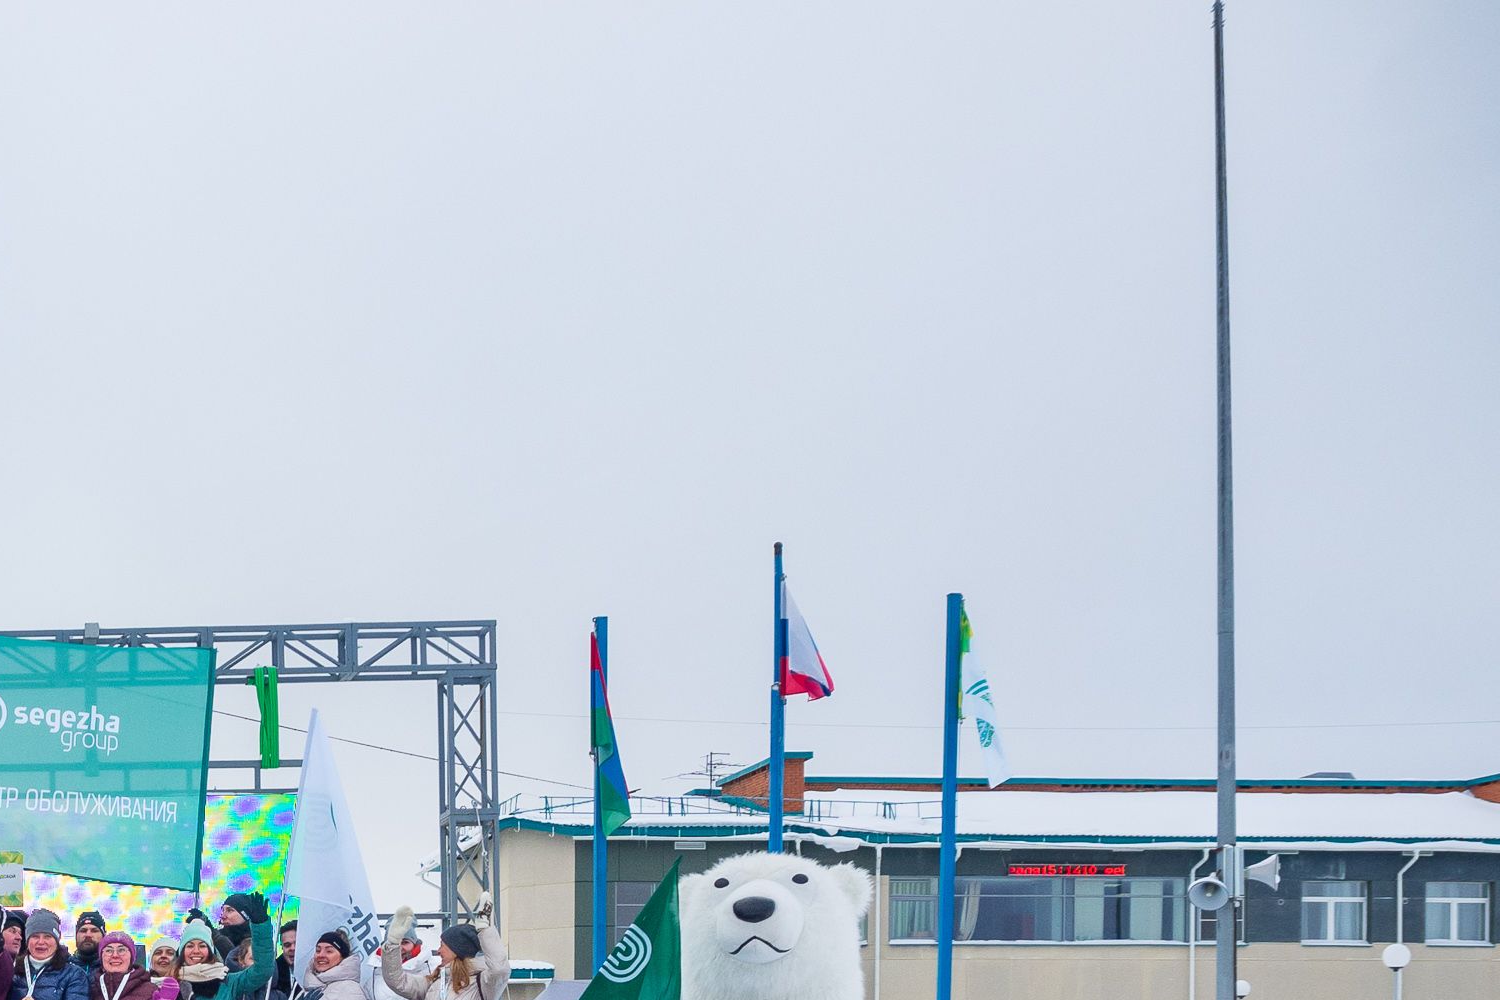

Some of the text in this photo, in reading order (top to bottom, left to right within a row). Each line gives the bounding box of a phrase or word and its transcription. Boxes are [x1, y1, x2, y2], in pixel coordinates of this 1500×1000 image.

[14, 705, 120, 733] segezha
[60, 729, 119, 756] group
[25, 788, 178, 823] ОБСЛУЖИВАНИЯ
